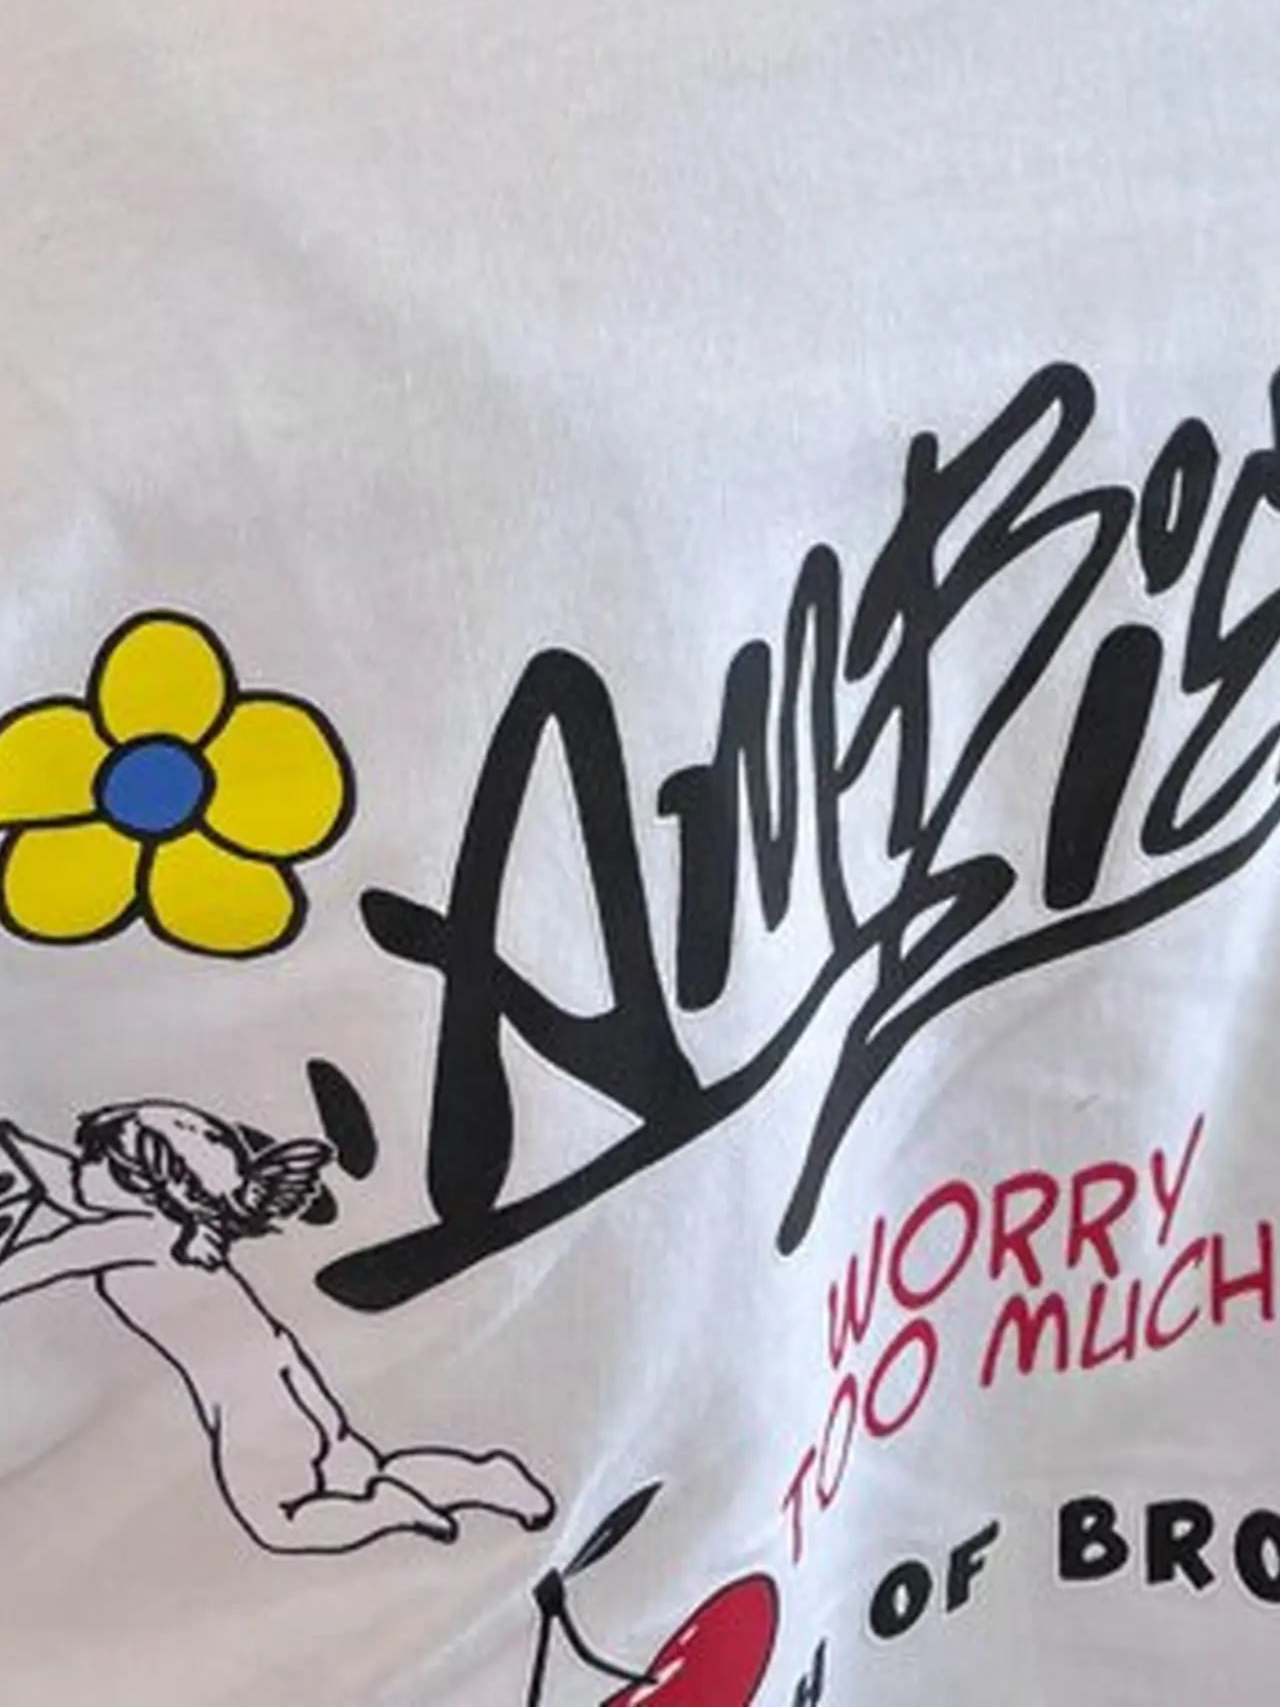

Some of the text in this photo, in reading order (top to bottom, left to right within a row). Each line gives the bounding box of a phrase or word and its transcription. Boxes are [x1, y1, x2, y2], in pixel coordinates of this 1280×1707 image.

[828, 1113, 1204, 1370] WORRY
[782, 1219, 1275, 1566] TOO MUCH
[869, 1520, 1000, 1640] OF
